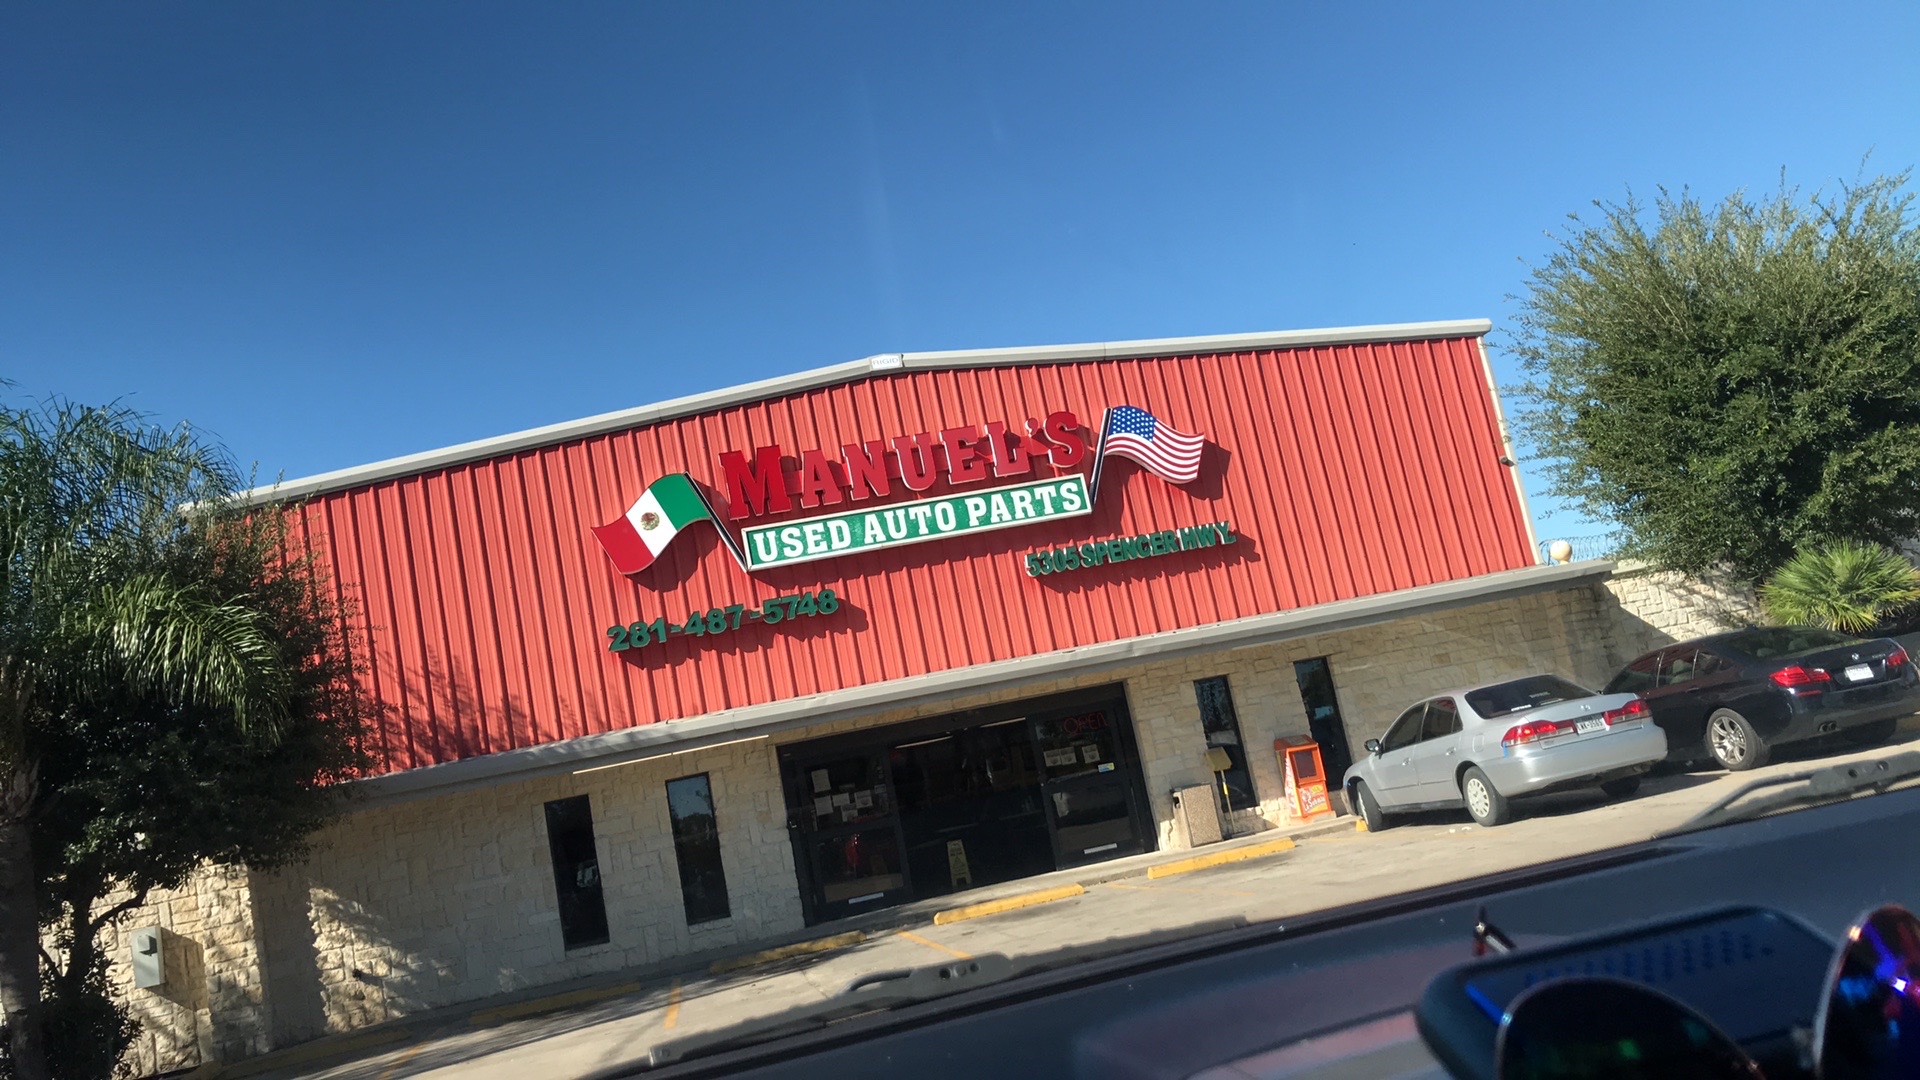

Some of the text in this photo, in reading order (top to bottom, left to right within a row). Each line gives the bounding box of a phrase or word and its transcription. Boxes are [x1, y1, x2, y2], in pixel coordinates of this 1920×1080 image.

[719, 411, 1085, 521] MANUEL'S
[753, 481, 1083, 563] USED AUTO PARTS
[1024, 543, 1080, 577] 5305
[1078, 529, 1180, 567] SPENCER
[606, 589, 839, 652] 281-487-5748
